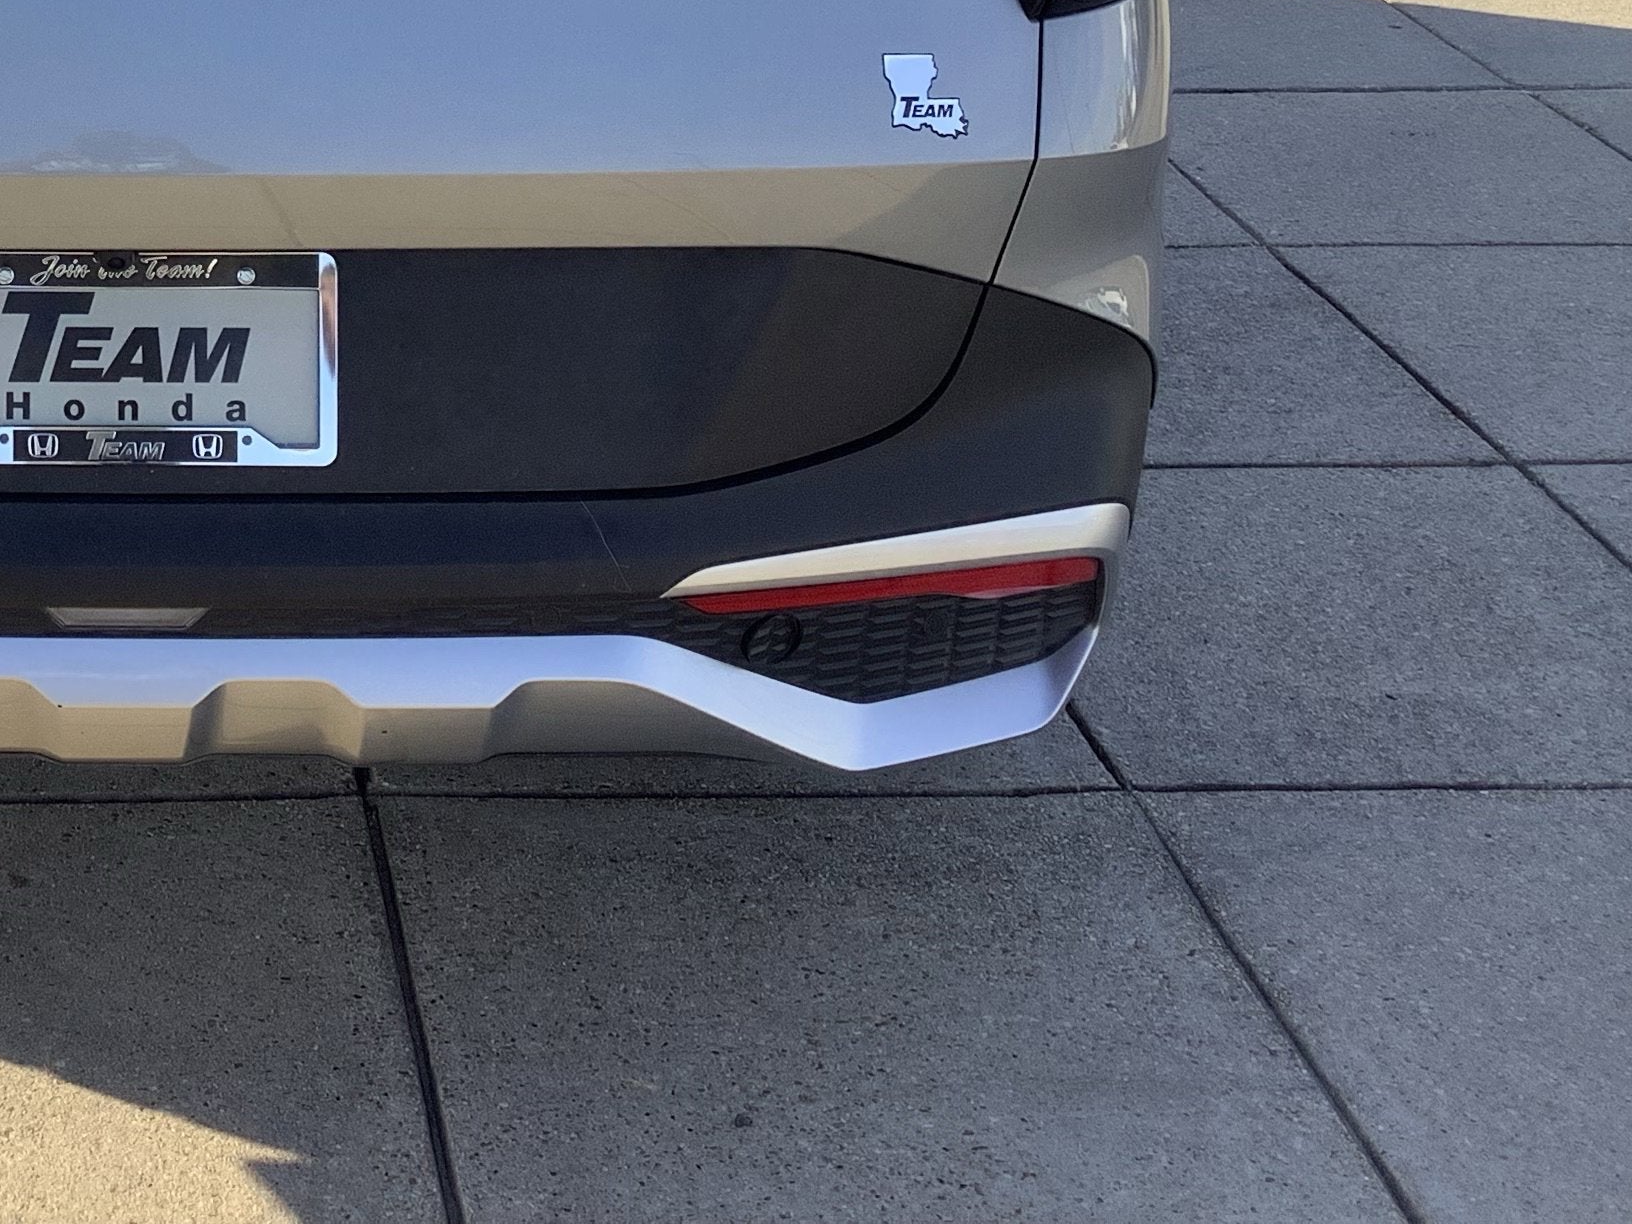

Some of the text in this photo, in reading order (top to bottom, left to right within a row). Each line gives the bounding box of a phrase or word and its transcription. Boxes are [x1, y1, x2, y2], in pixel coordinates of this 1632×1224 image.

[900, 96, 954, 118] TEAM
[29, 255, 91, 286] Join
[140, 255, 218, 280] Team!
[1, 291, 251, 384] TEAM
[5, 391, 248, 422] Honda
[85, 431, 166, 461] TEAM
